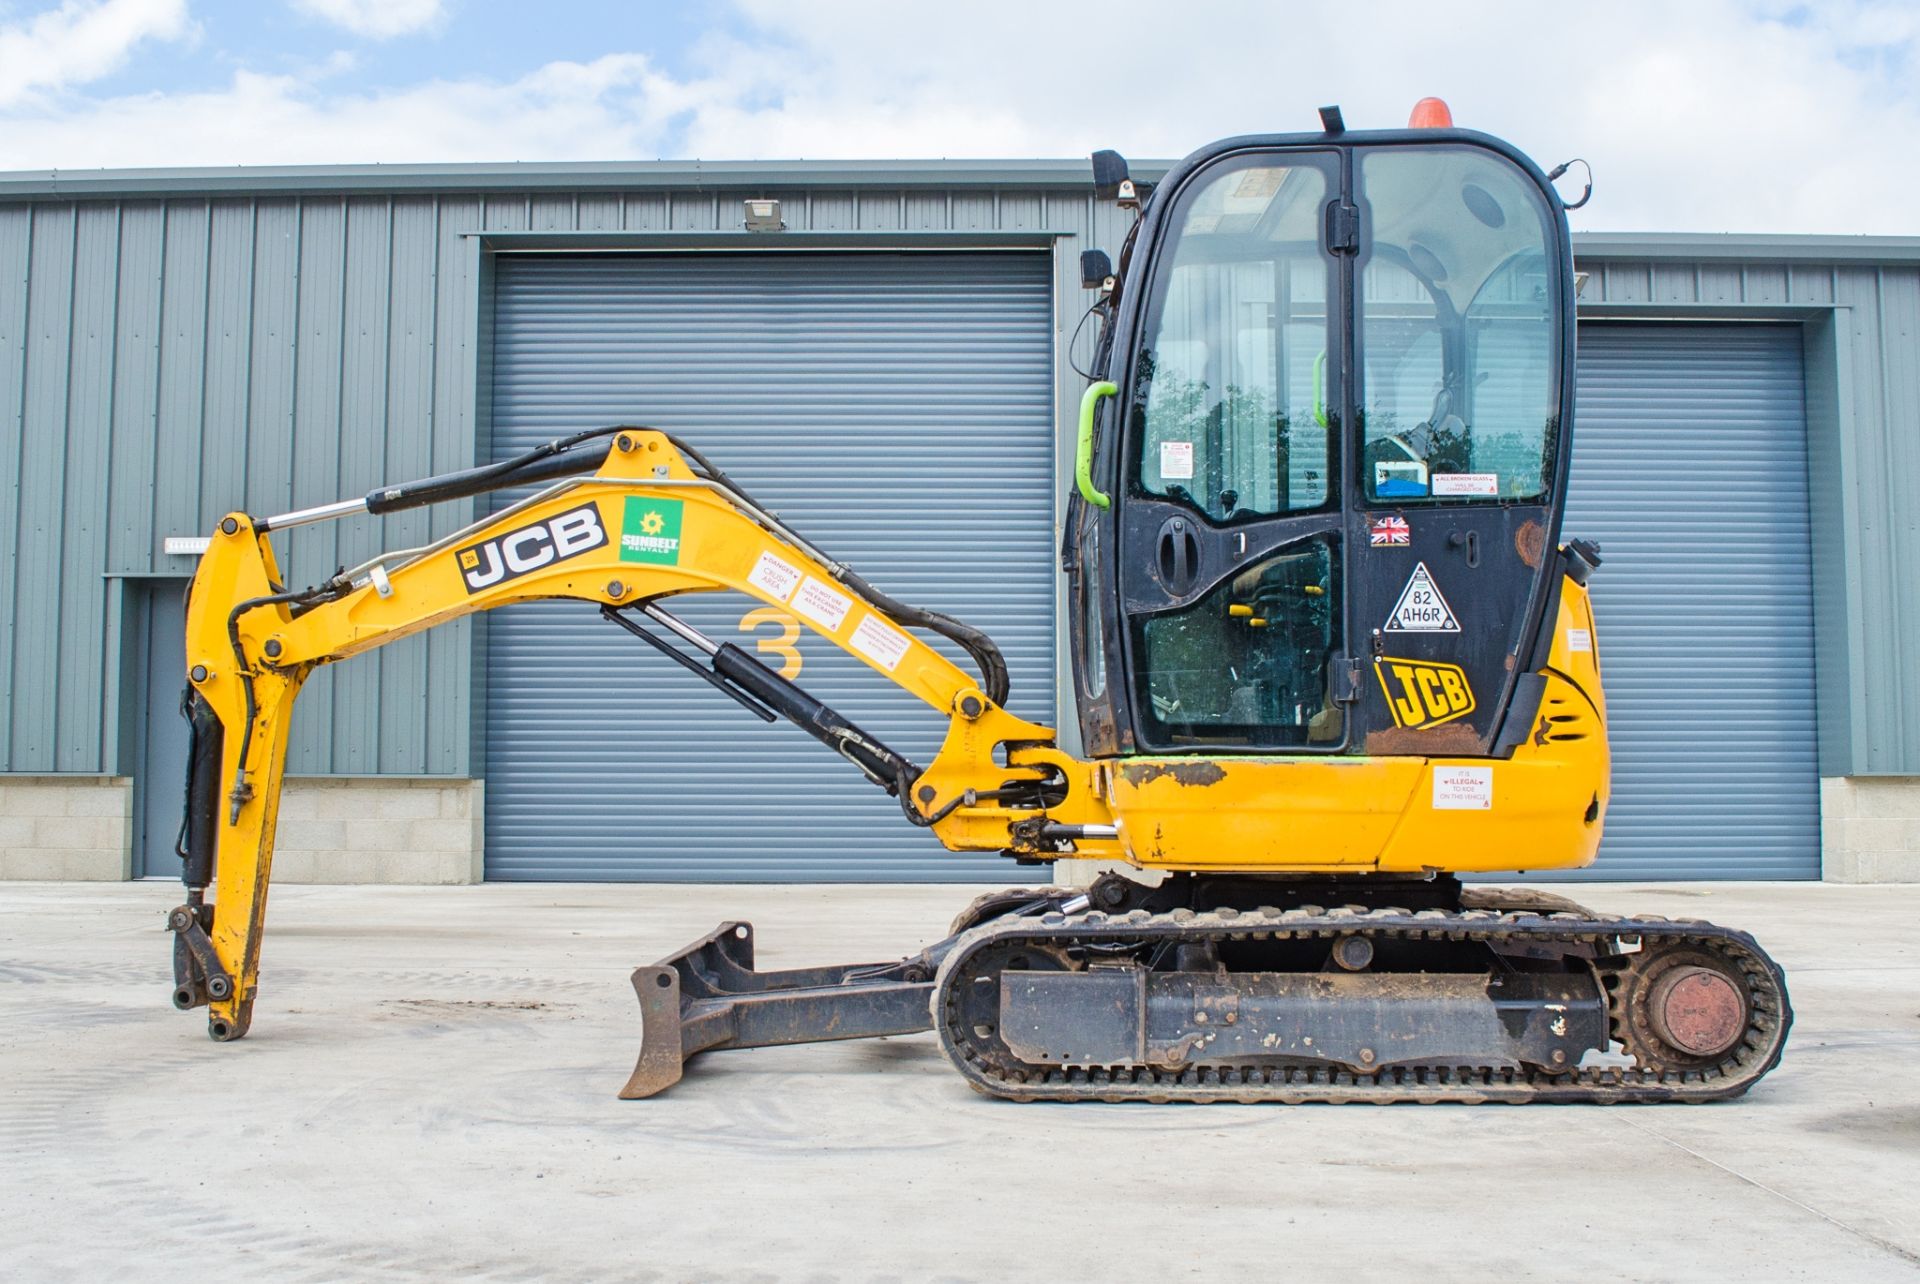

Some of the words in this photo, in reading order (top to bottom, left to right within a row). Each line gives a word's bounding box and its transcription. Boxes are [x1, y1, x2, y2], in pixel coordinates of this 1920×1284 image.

[466, 508, 604, 589] JCB
[621, 534, 678, 550] SUNBELT
[628, 545, 669, 554] RENTALS
[768, 558, 794, 576] DANGER
[761, 576, 780, 590] AREA
[764, 567, 787, 584] CRUSH
[810, 584, 819, 593] DO
[819, 589, 831, 600] NOT
[1413, 591, 1431, 605] 82
[802, 587, 814, 597] THIS
[814, 594, 845, 615] EXCAVATOR
[817, 604, 835, 617] CRANE
[1403, 608, 1440, 622] AH6R
[738, 607, 803, 681] 3
[1392, 665, 1468, 727] JCB
